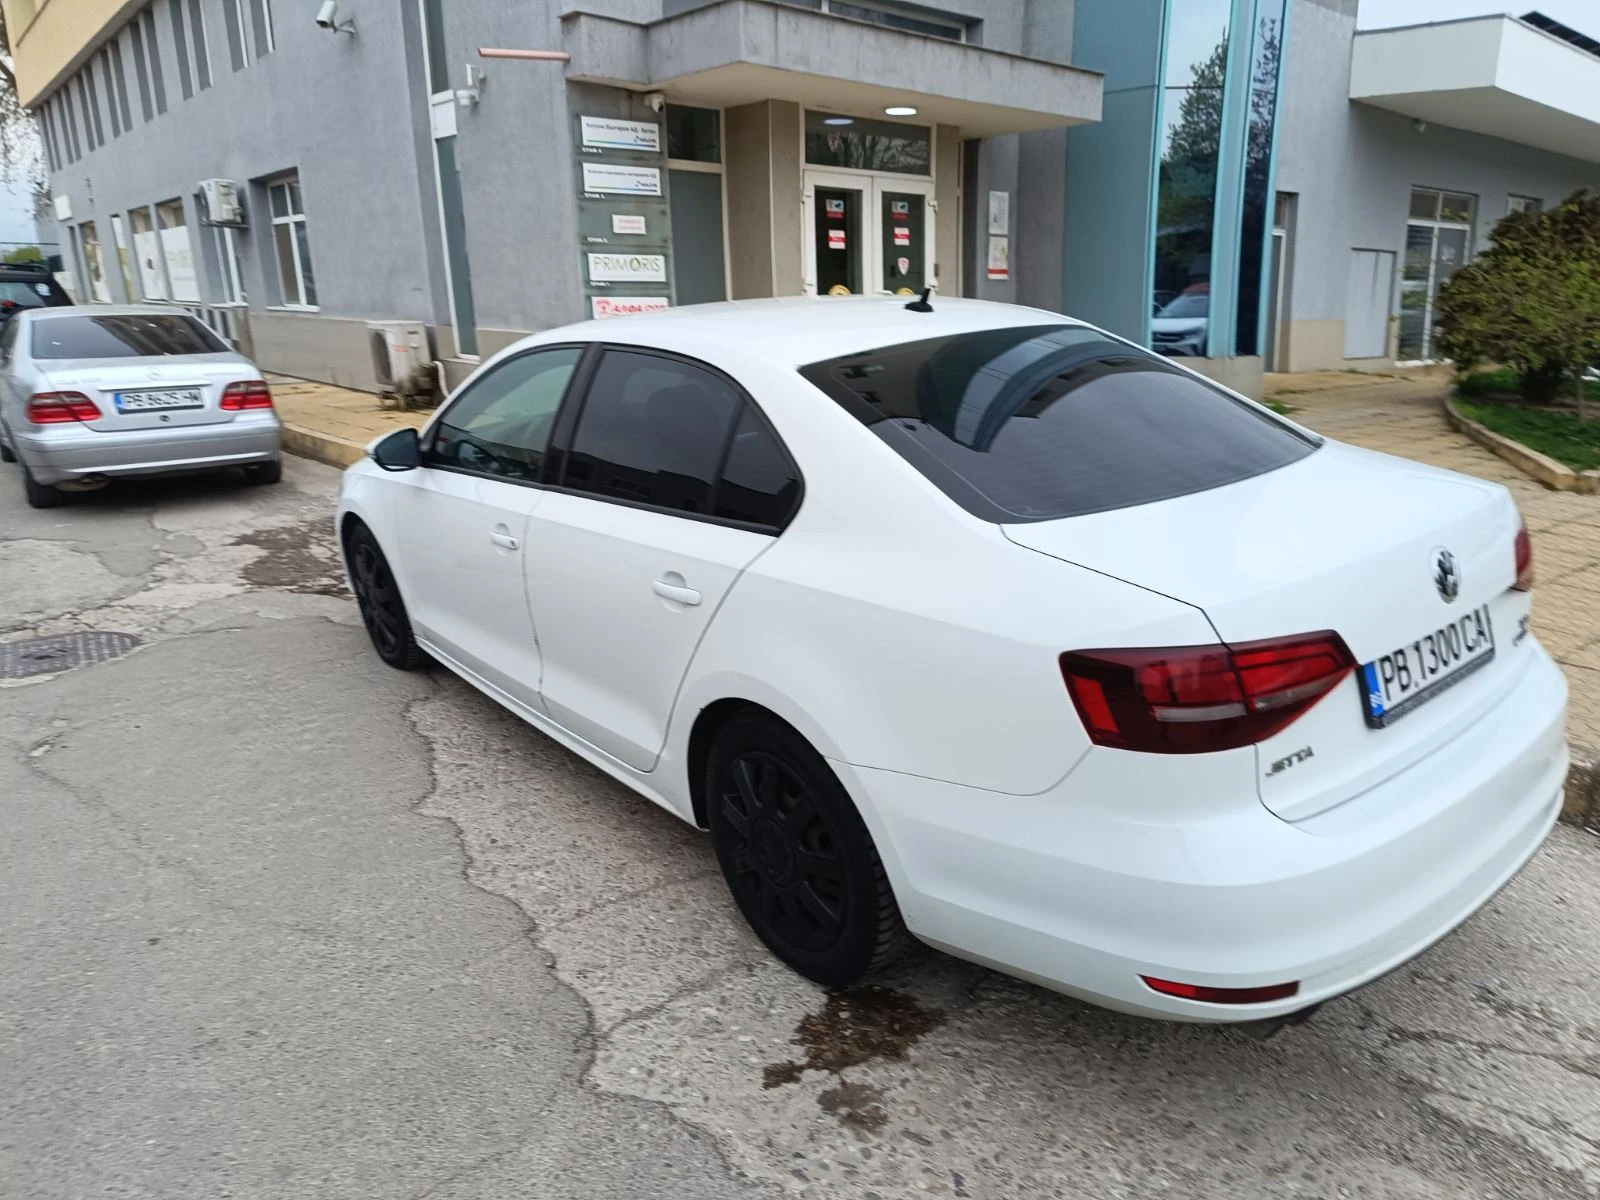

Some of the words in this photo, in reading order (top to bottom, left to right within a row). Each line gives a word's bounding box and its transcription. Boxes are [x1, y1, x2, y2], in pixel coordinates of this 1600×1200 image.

[593, 255, 661, 272] PRIMORIS
[1379, 650, 1412, 701] PB
[1414, 622, 1460, 681] 1300
